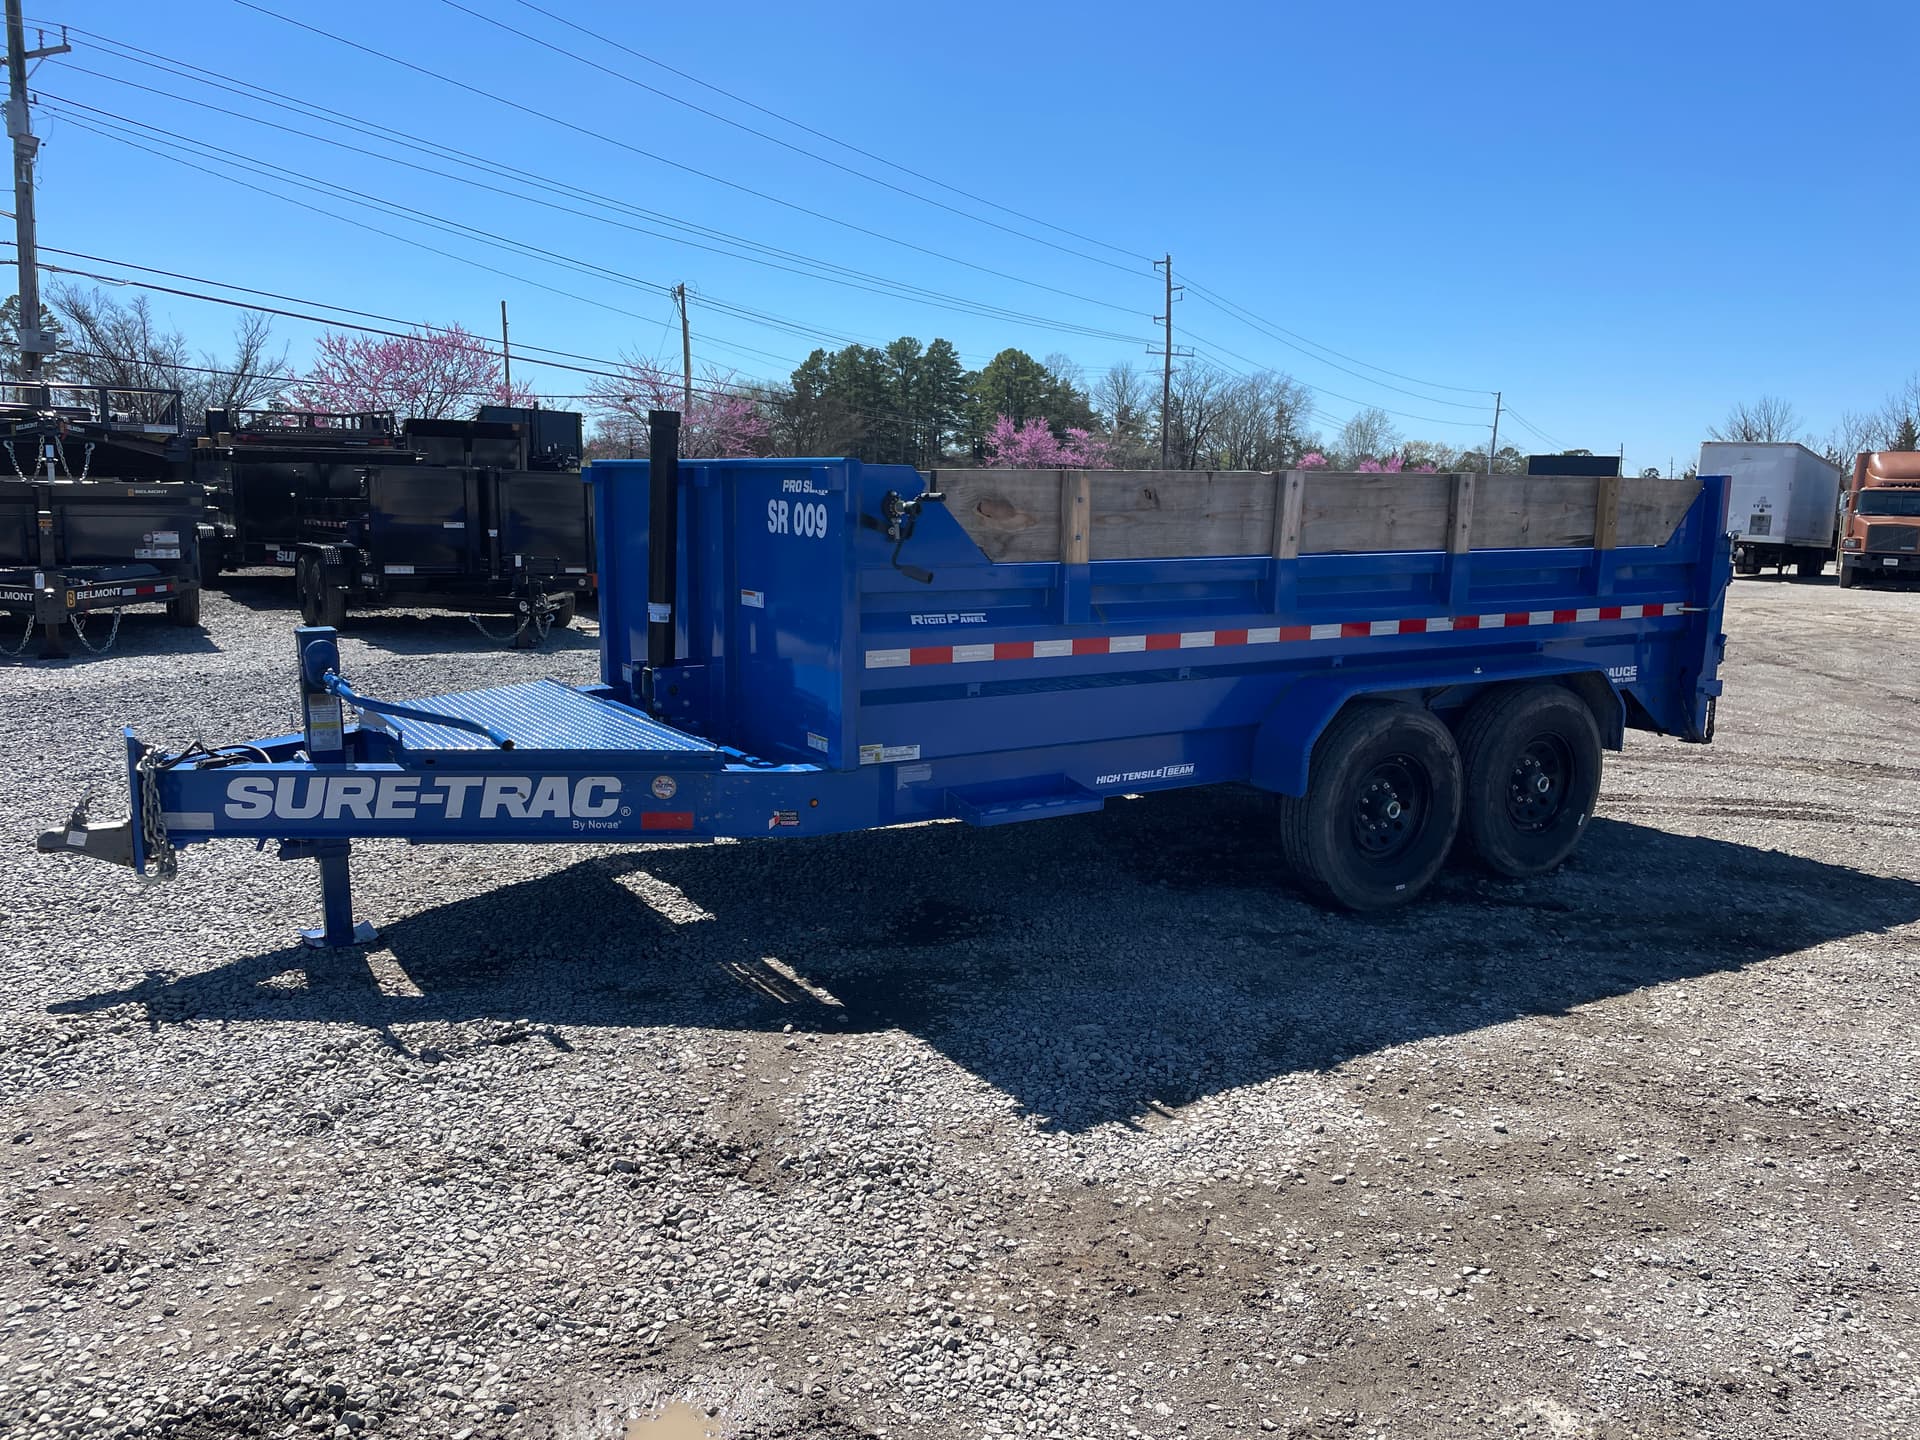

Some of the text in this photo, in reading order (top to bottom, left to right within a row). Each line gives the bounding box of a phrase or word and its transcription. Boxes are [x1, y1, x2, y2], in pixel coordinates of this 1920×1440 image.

[783, 479, 802, 493] PRO
[768, 499, 828, 539] SR 009
[0, 591, 34, 601] LMONT
[77, 587, 122, 600] BELMONT
[1605, 665, 1638, 677] AUGE
[1096, 774, 1121, 785] HIGH
[1122, 768, 1163, 782] TENSILE
[224, 776, 622, 819] SURE-TRAC
[572, 820, 619, 831] By Novae
